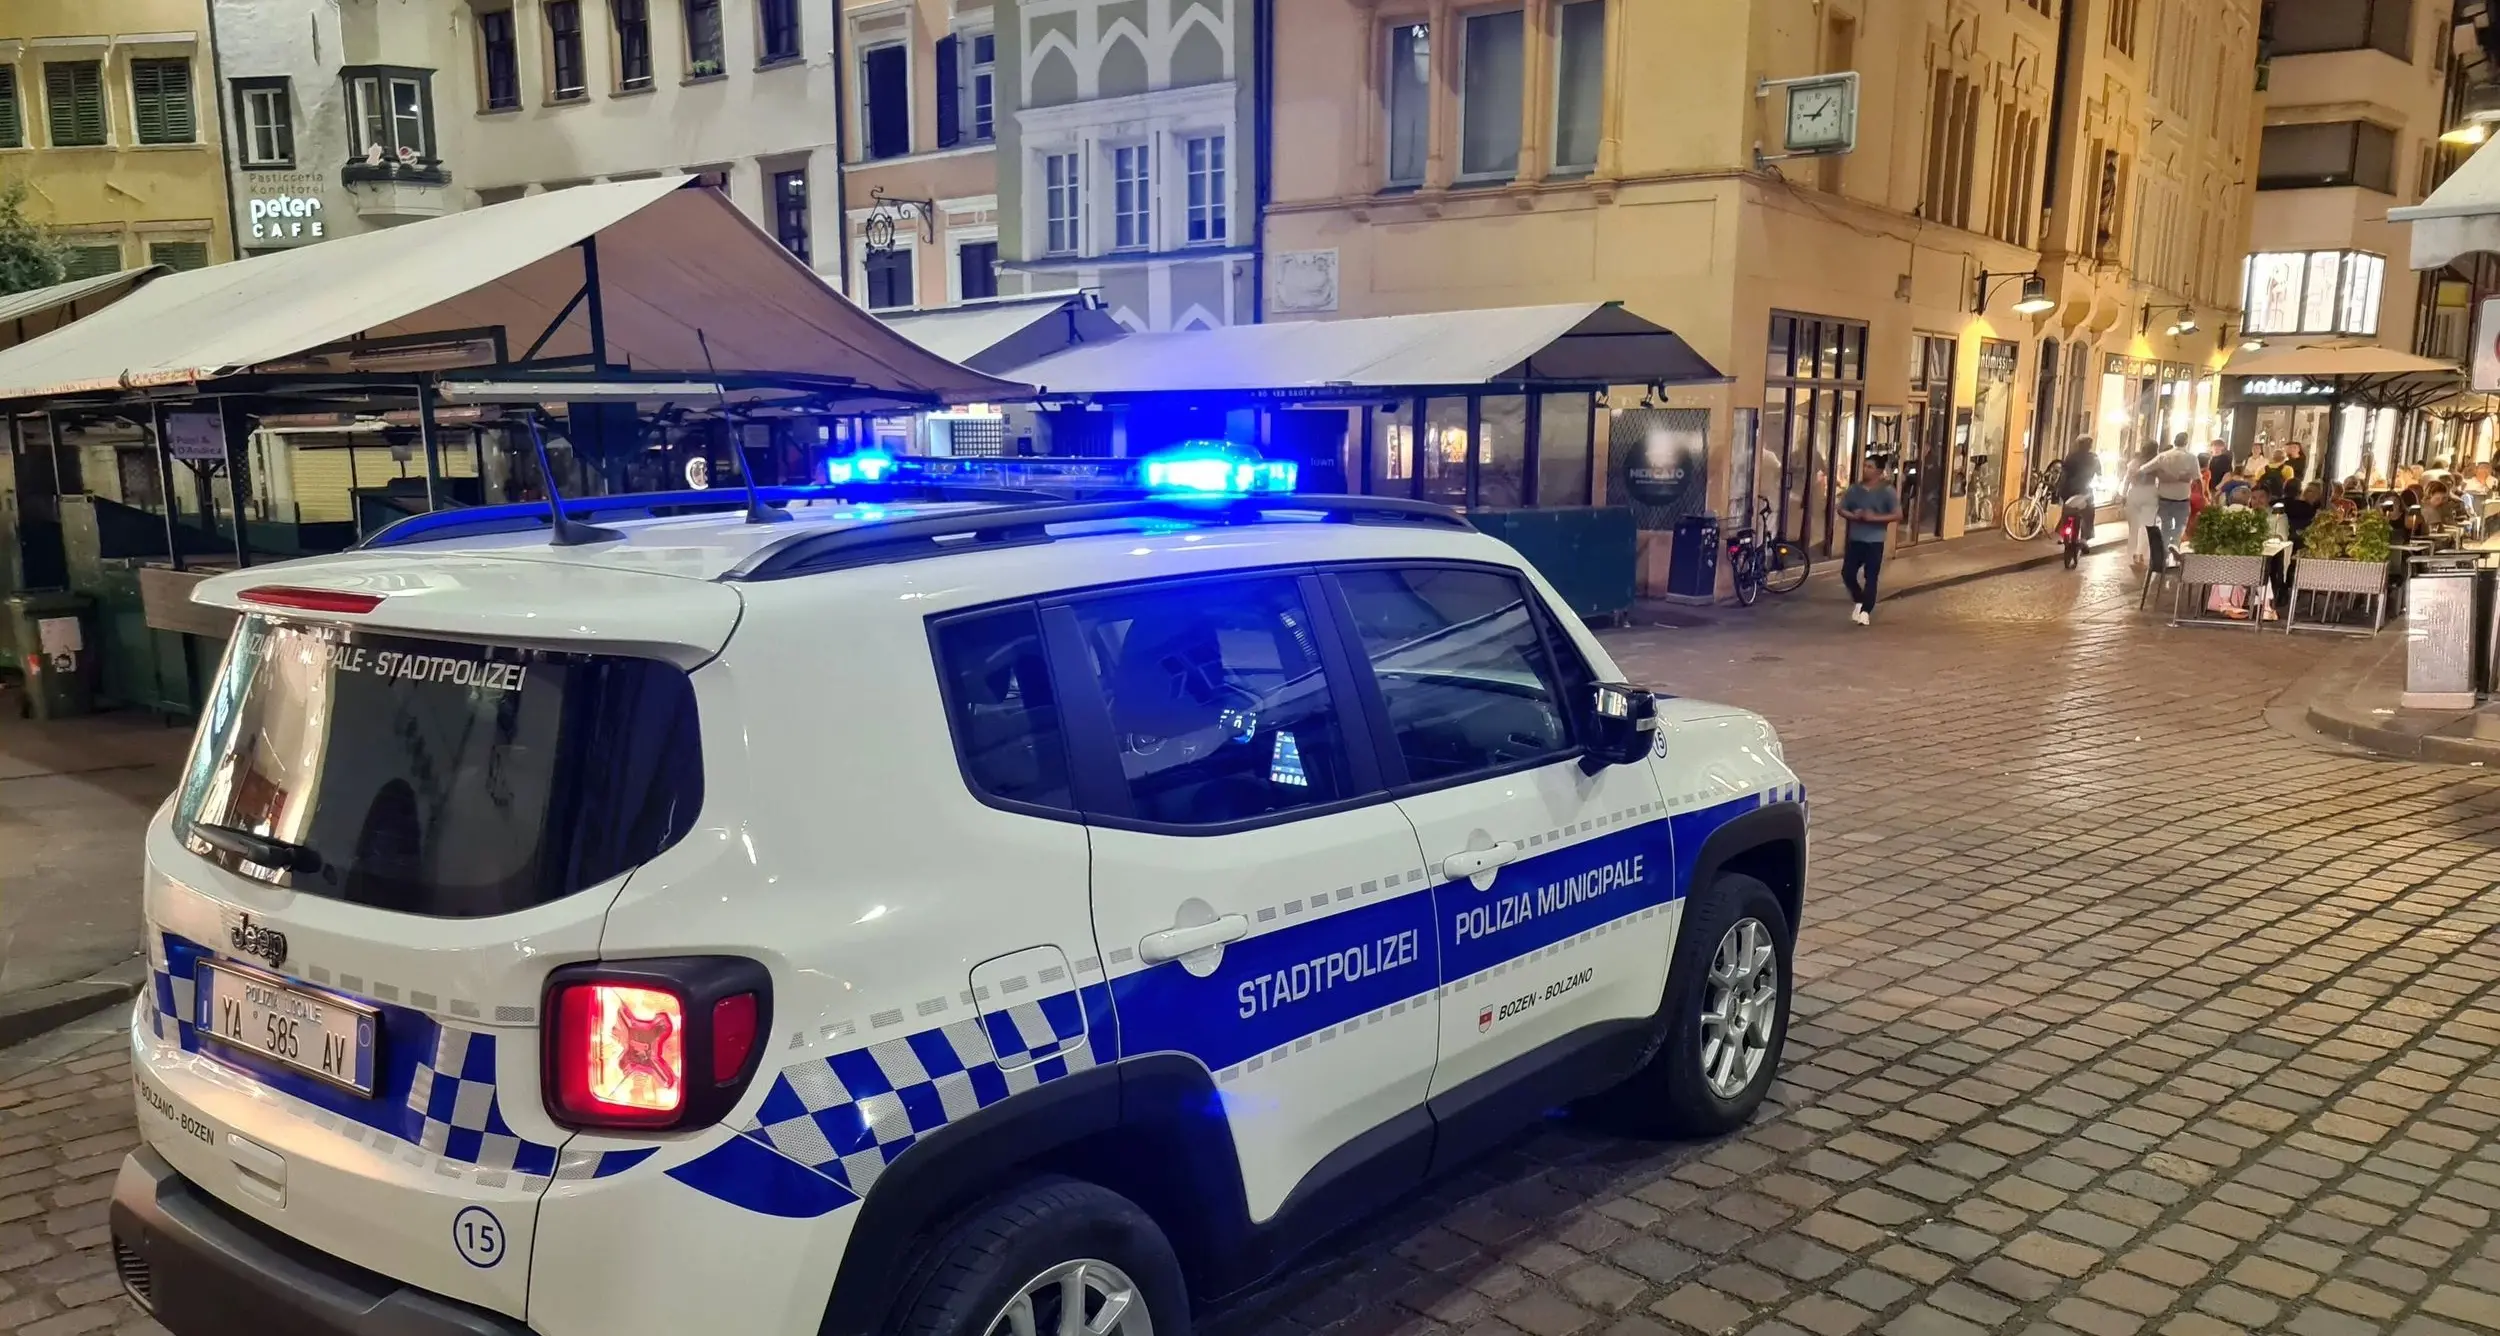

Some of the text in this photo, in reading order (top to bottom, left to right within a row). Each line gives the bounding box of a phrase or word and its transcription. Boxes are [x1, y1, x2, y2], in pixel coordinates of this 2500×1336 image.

[249, 173, 323, 182] Pasticceria
[250, 193, 321, 224] peter
[252, 221, 323, 238] CAFE
[375, 651, 527, 691] STADTPOLIZEI
[1456, 854, 1644, 945] POLIZIA MUNICIPALE
[231, 912, 288, 968] Jeep
[1238, 928, 1418, 1019] STADTPOLIZEI
[1498, 992, 1537, 1021] BOZEN
[1545, 967, 1593, 1000] BOLZANO
[223, 994, 347, 1076] YA 585 AV
[141, 1081, 174, 1120] BOLZANO
[181, 1113, 215, 1146] BOZEN
[464, 1222, 495, 1253] 15
